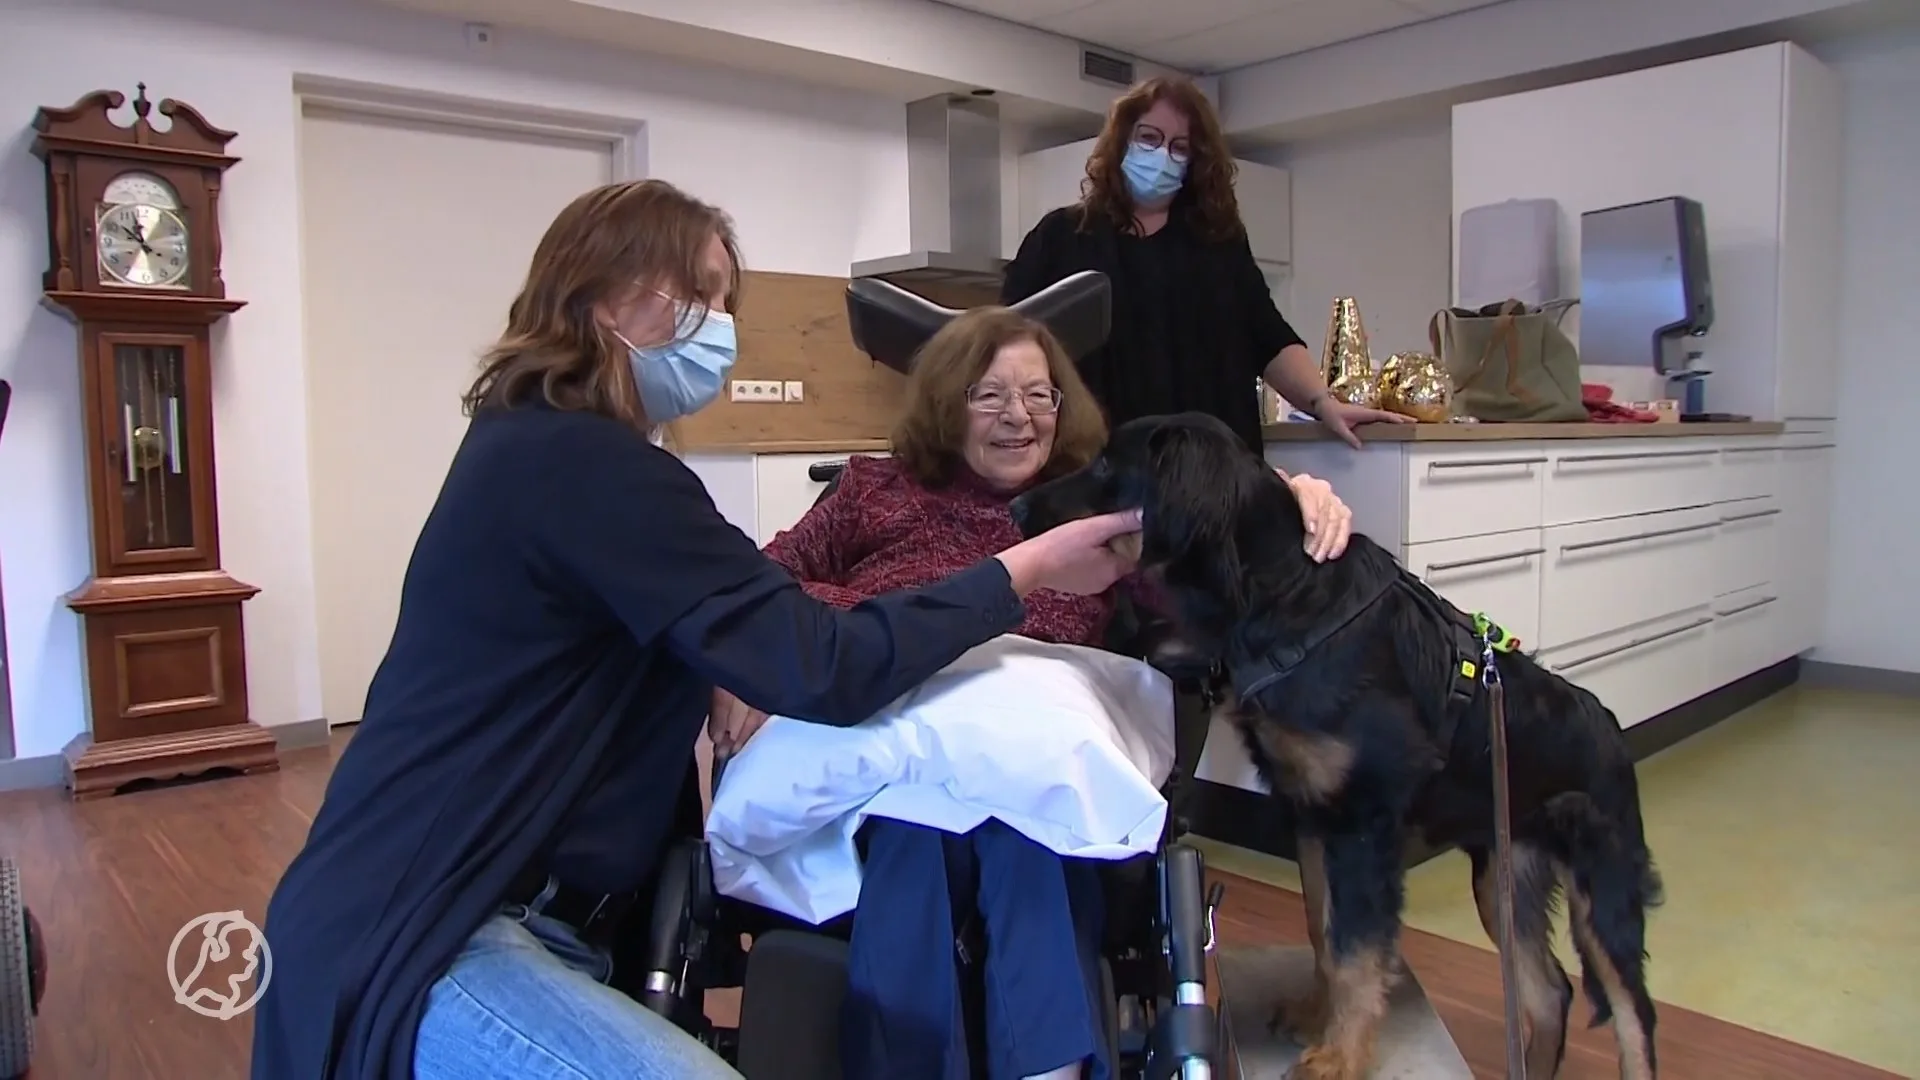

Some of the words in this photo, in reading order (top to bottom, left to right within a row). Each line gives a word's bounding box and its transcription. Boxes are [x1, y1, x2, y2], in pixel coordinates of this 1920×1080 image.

[120, 211, 129, 221] 11
[104, 237, 112, 248] 9
[142, 273, 150, 283] 6
